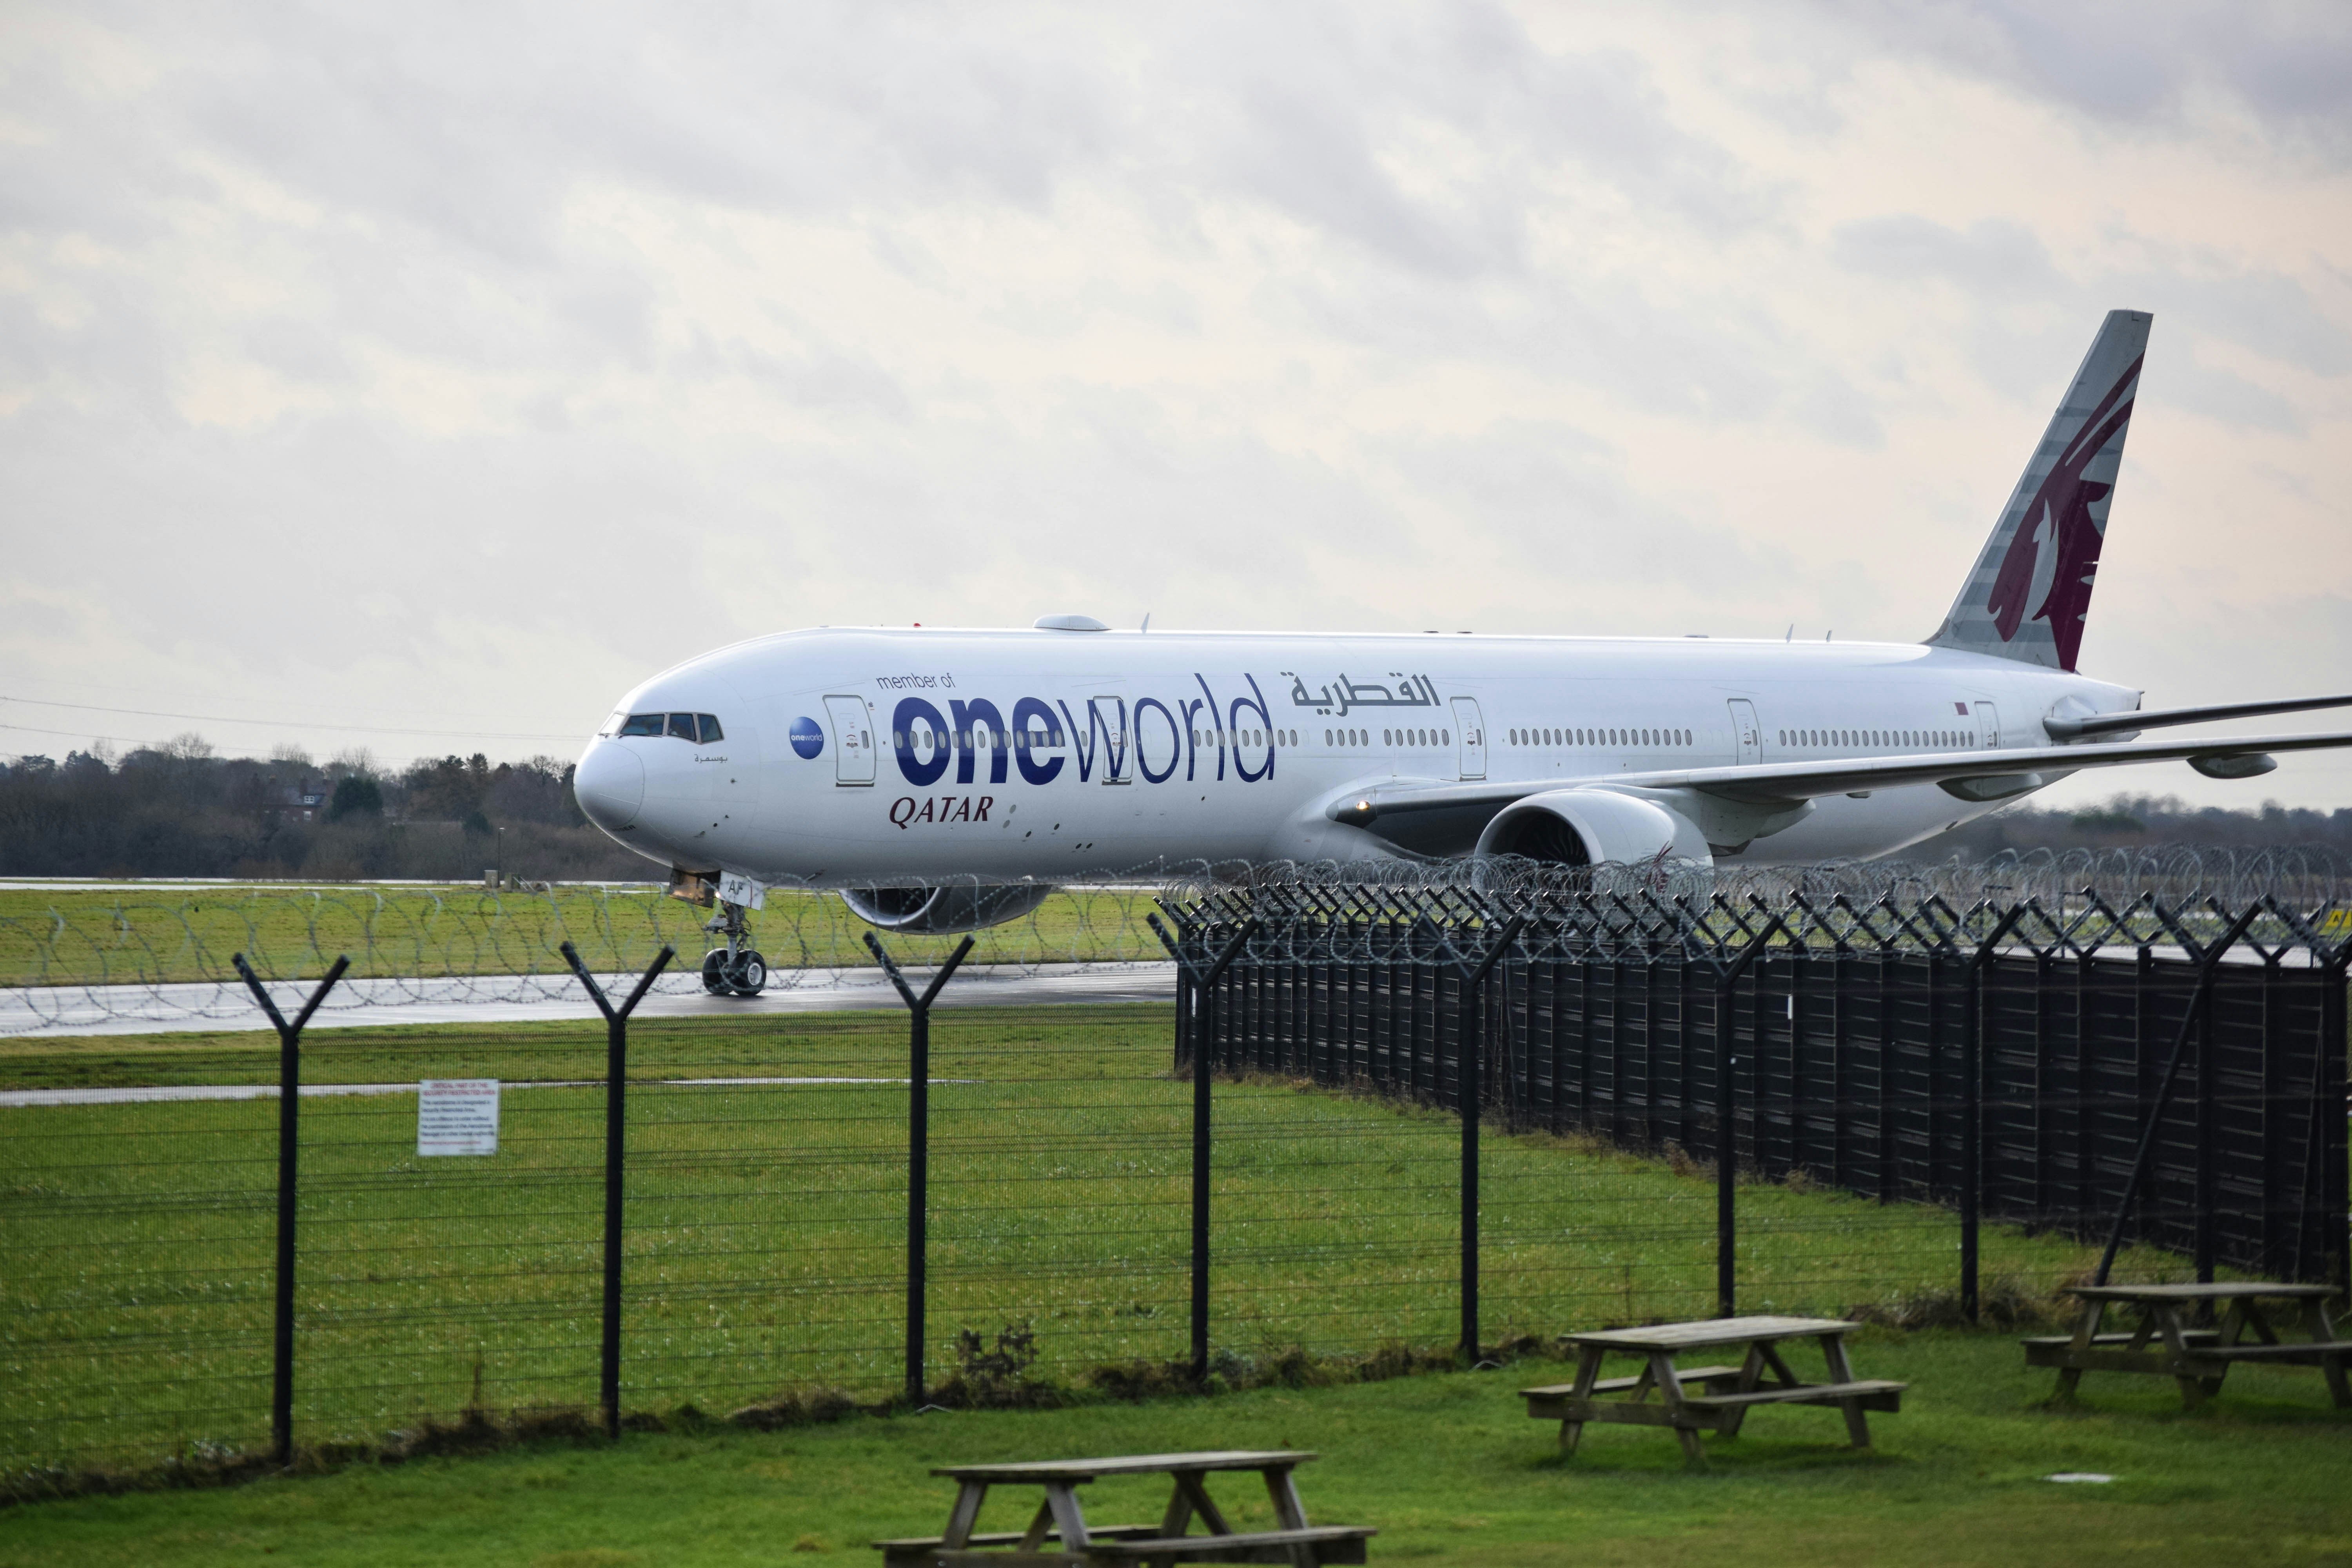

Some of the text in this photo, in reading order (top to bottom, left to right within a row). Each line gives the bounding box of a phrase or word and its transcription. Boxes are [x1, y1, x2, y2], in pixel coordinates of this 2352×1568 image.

[876, 672, 956, 689] member of
[1279, 671, 1441, 717] القطرية
[892, 673, 1275, 786] oneworld
[889, 796, 994, 829] QATAR
